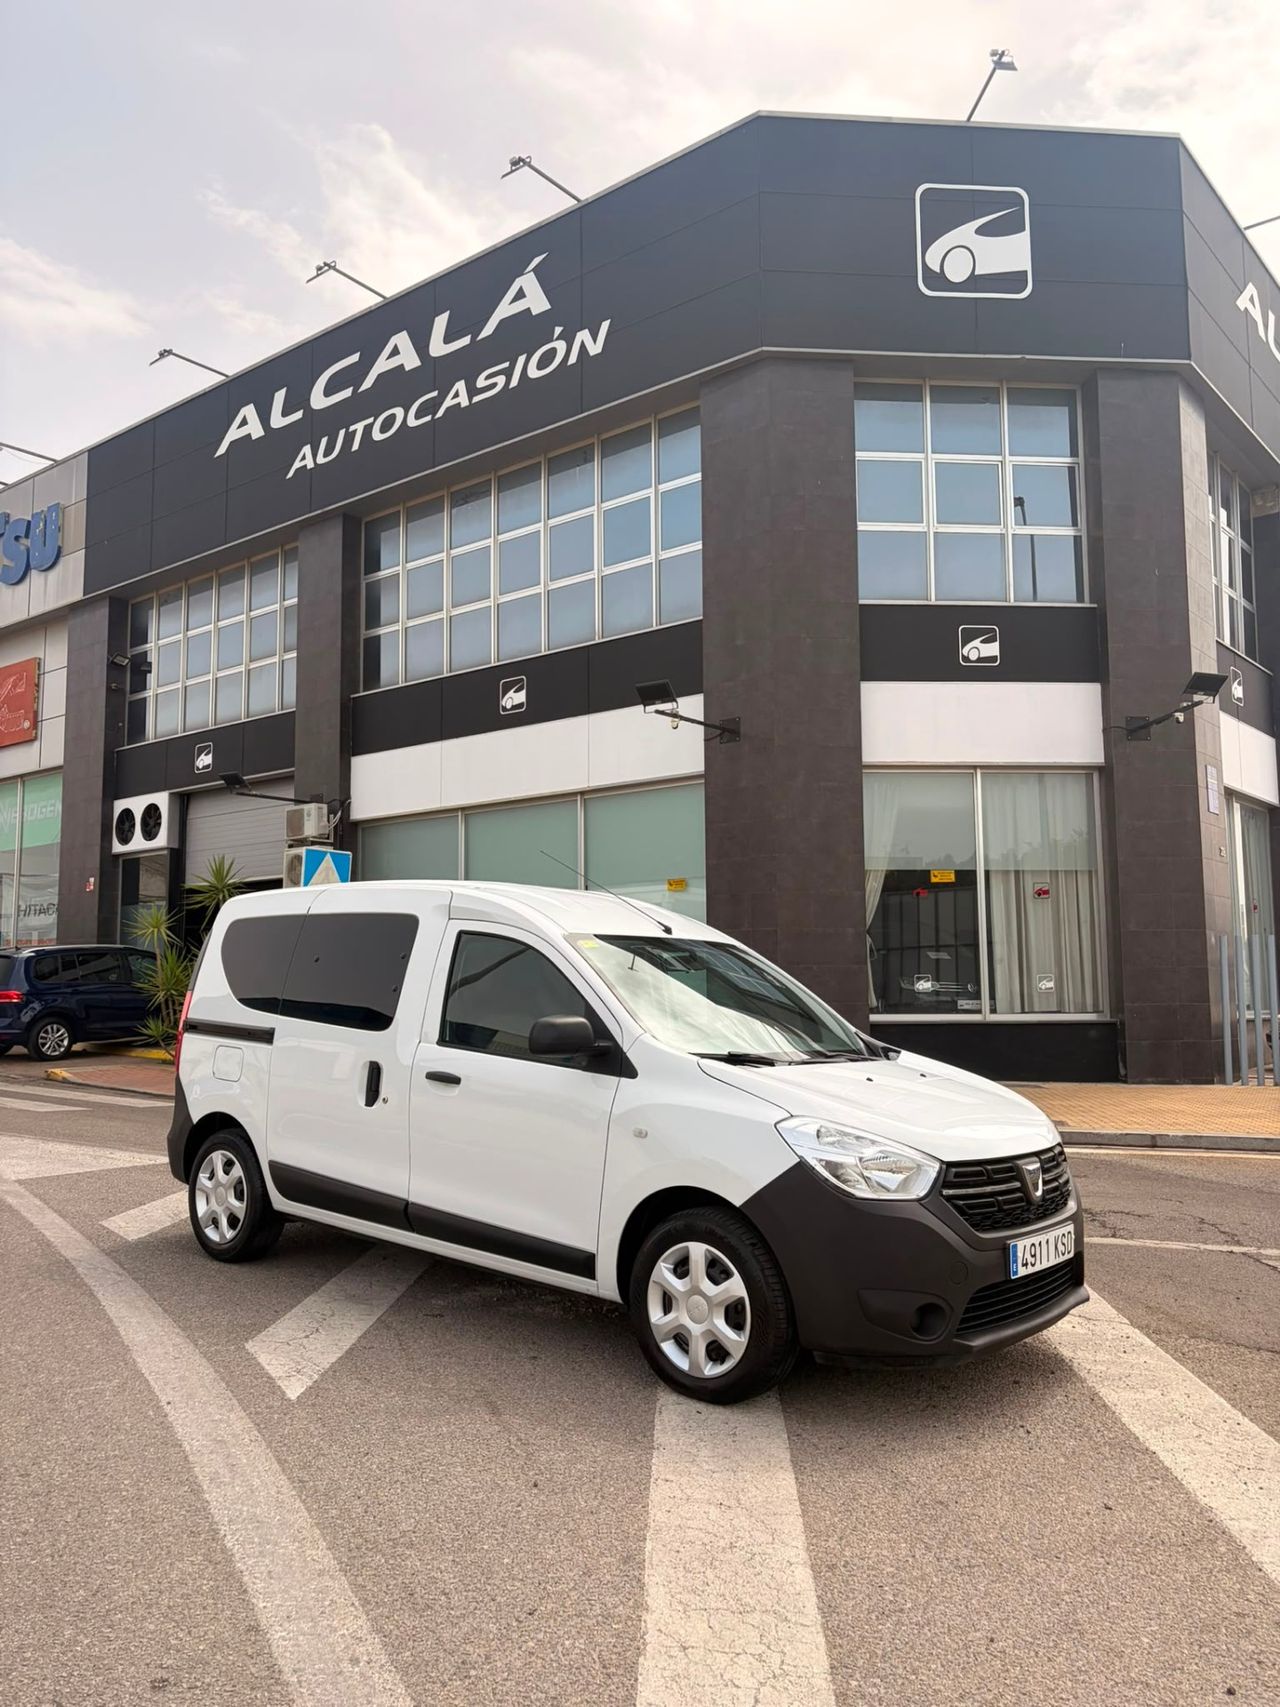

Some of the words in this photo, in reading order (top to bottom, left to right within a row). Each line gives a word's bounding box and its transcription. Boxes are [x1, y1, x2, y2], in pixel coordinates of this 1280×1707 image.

[213, 252, 552, 458] ALCALÁ
[285, 318, 612, 480] AUTOCASIÓN
[1021, 1239, 1050, 1270] 4911
[1054, 1230, 1073, 1260] KSD
